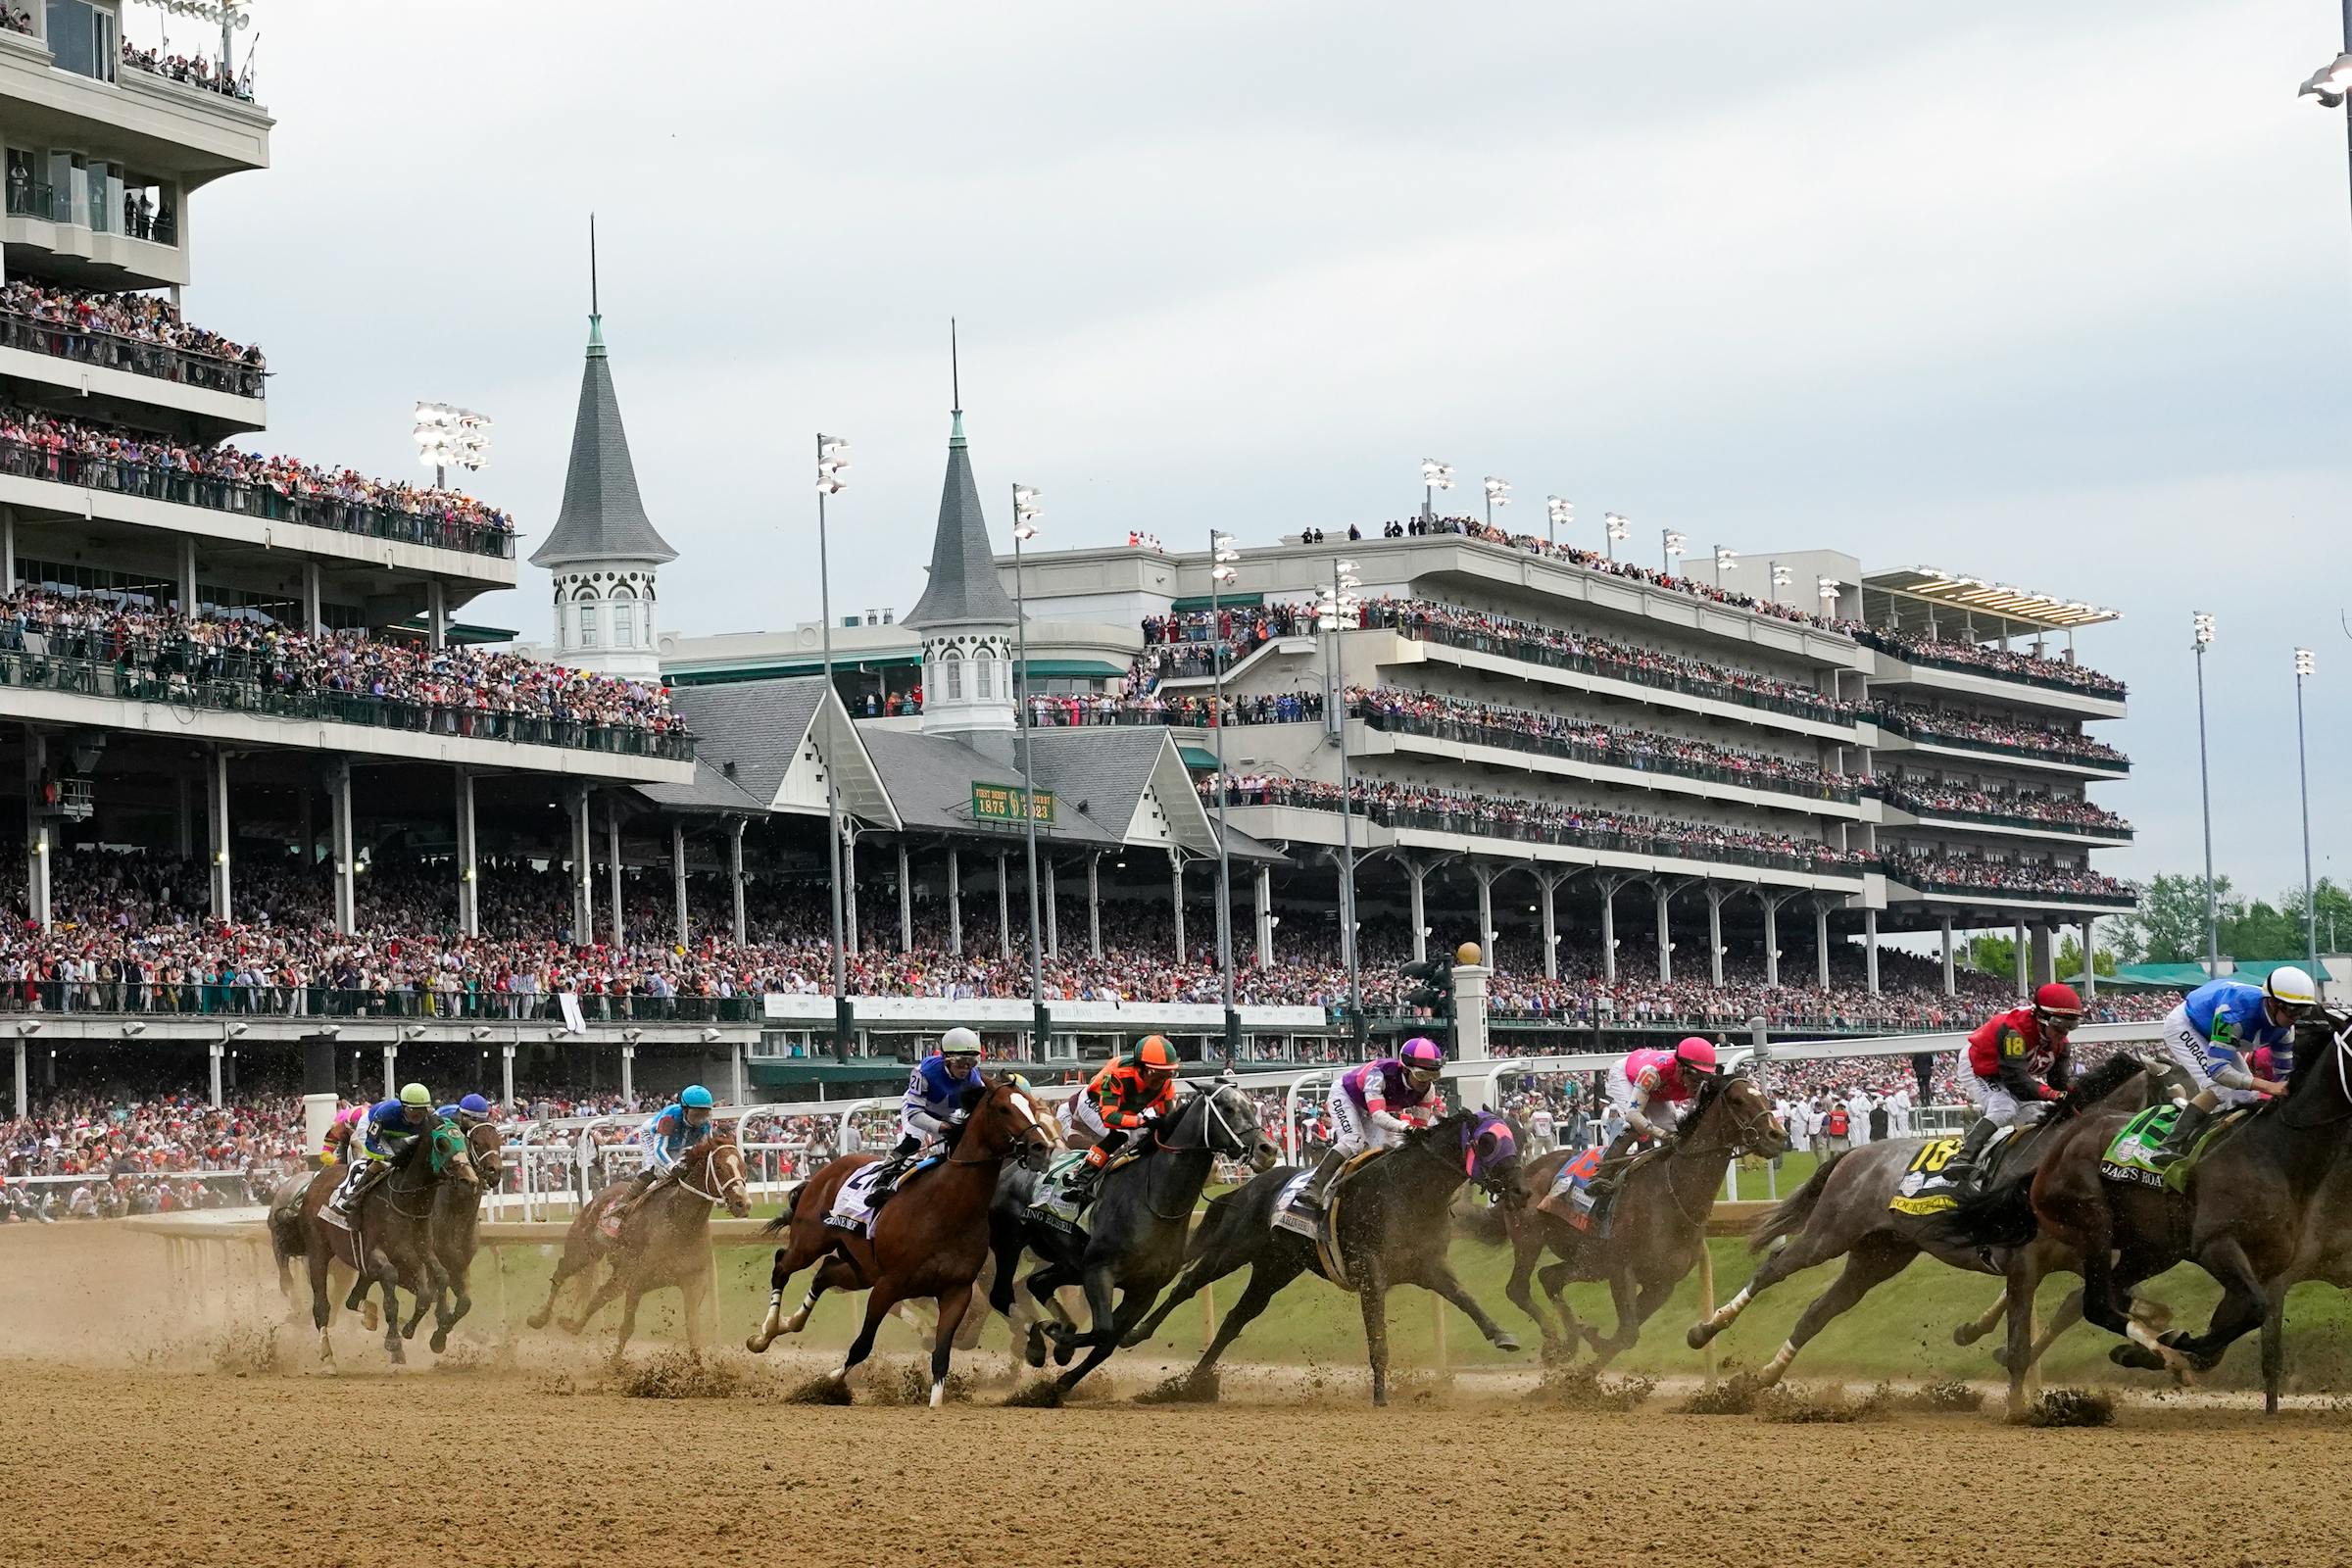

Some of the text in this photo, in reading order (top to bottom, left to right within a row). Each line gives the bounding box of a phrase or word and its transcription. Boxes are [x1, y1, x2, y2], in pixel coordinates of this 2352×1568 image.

[980, 800, 1004, 814] 1875
[2214, 1017, 2230, 1037] 12
[2005, 1037, 2025, 1056] 18
[909, 1075, 920, 1092] 21
[1365, 1074, 1382, 1091] 22
[1636, 1070, 1657, 1091] 16
[368, 1120, 380, 1136] 13
[2132, 1104, 2178, 1143] 12
[2141, 1171, 2164, 1187] ROA
